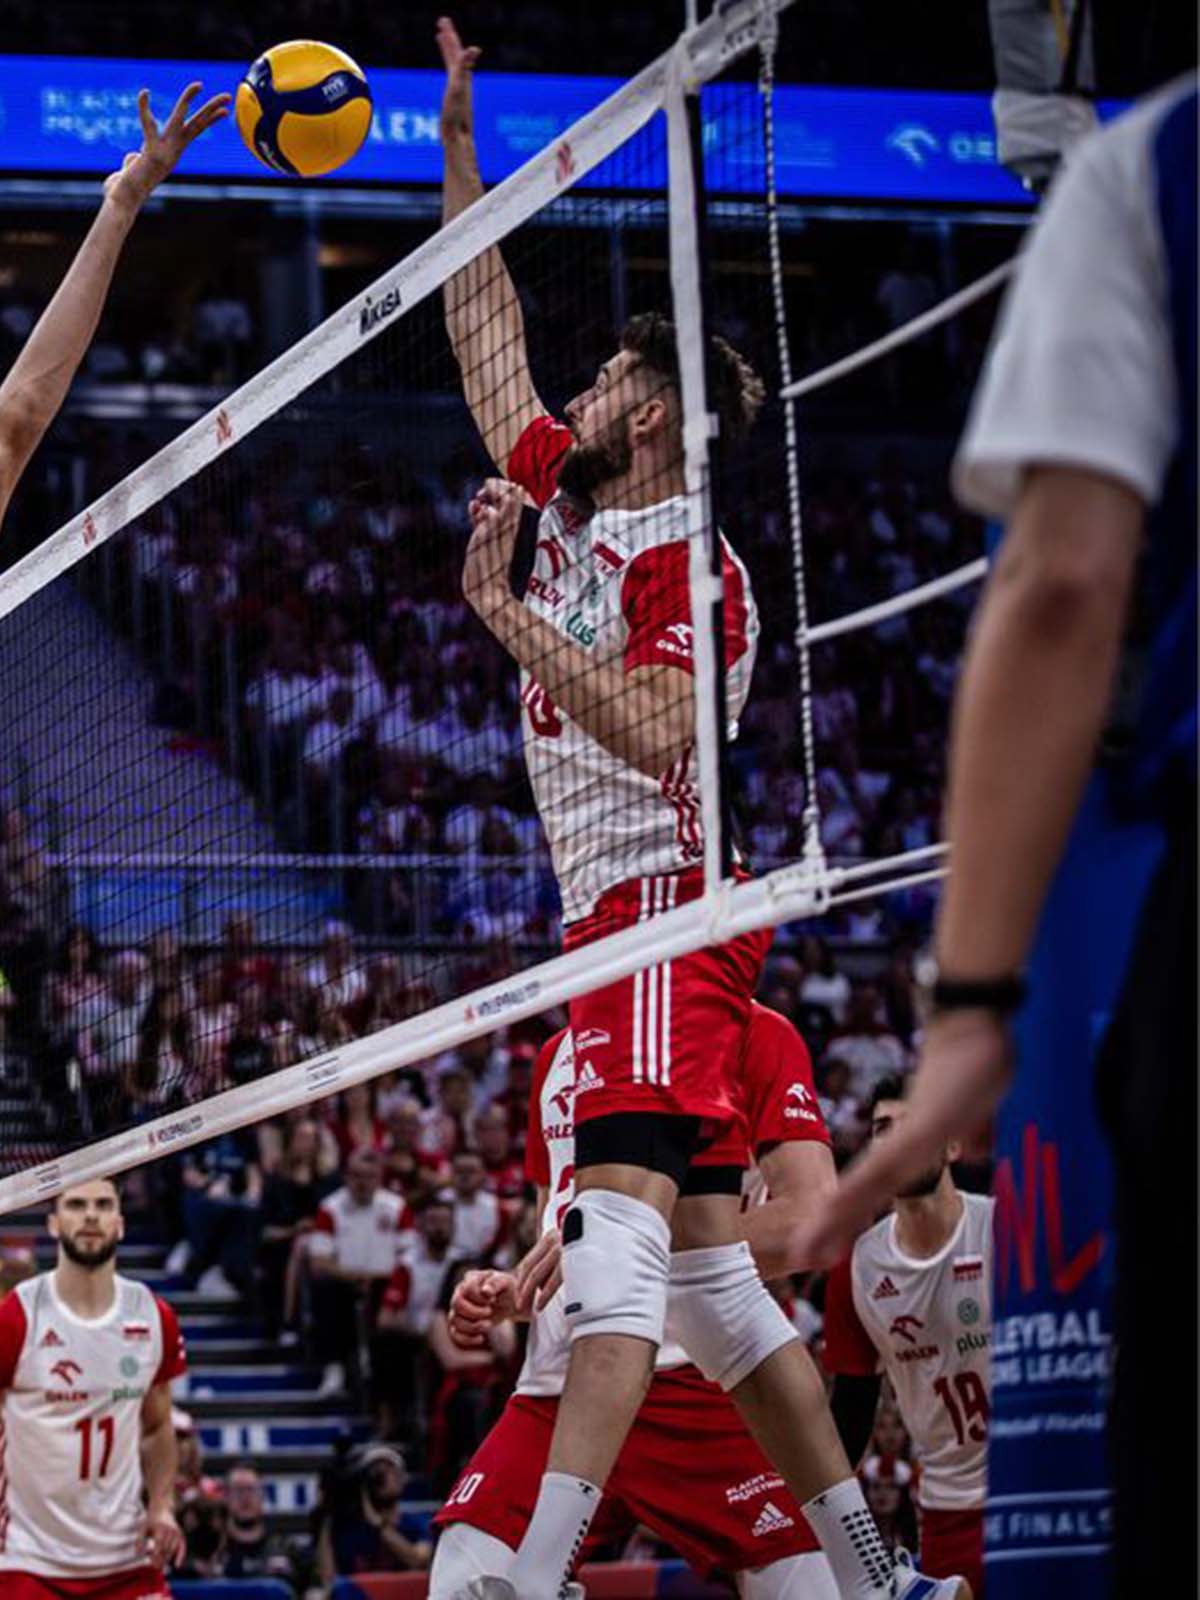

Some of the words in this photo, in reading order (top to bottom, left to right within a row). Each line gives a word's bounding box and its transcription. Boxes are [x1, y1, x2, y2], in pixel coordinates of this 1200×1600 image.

[372, 110, 440, 141] LEN
[956, 1335, 990, 1355] plu
[934, 1371, 990, 1445] 19
[75, 1416, 114, 1480] 11
